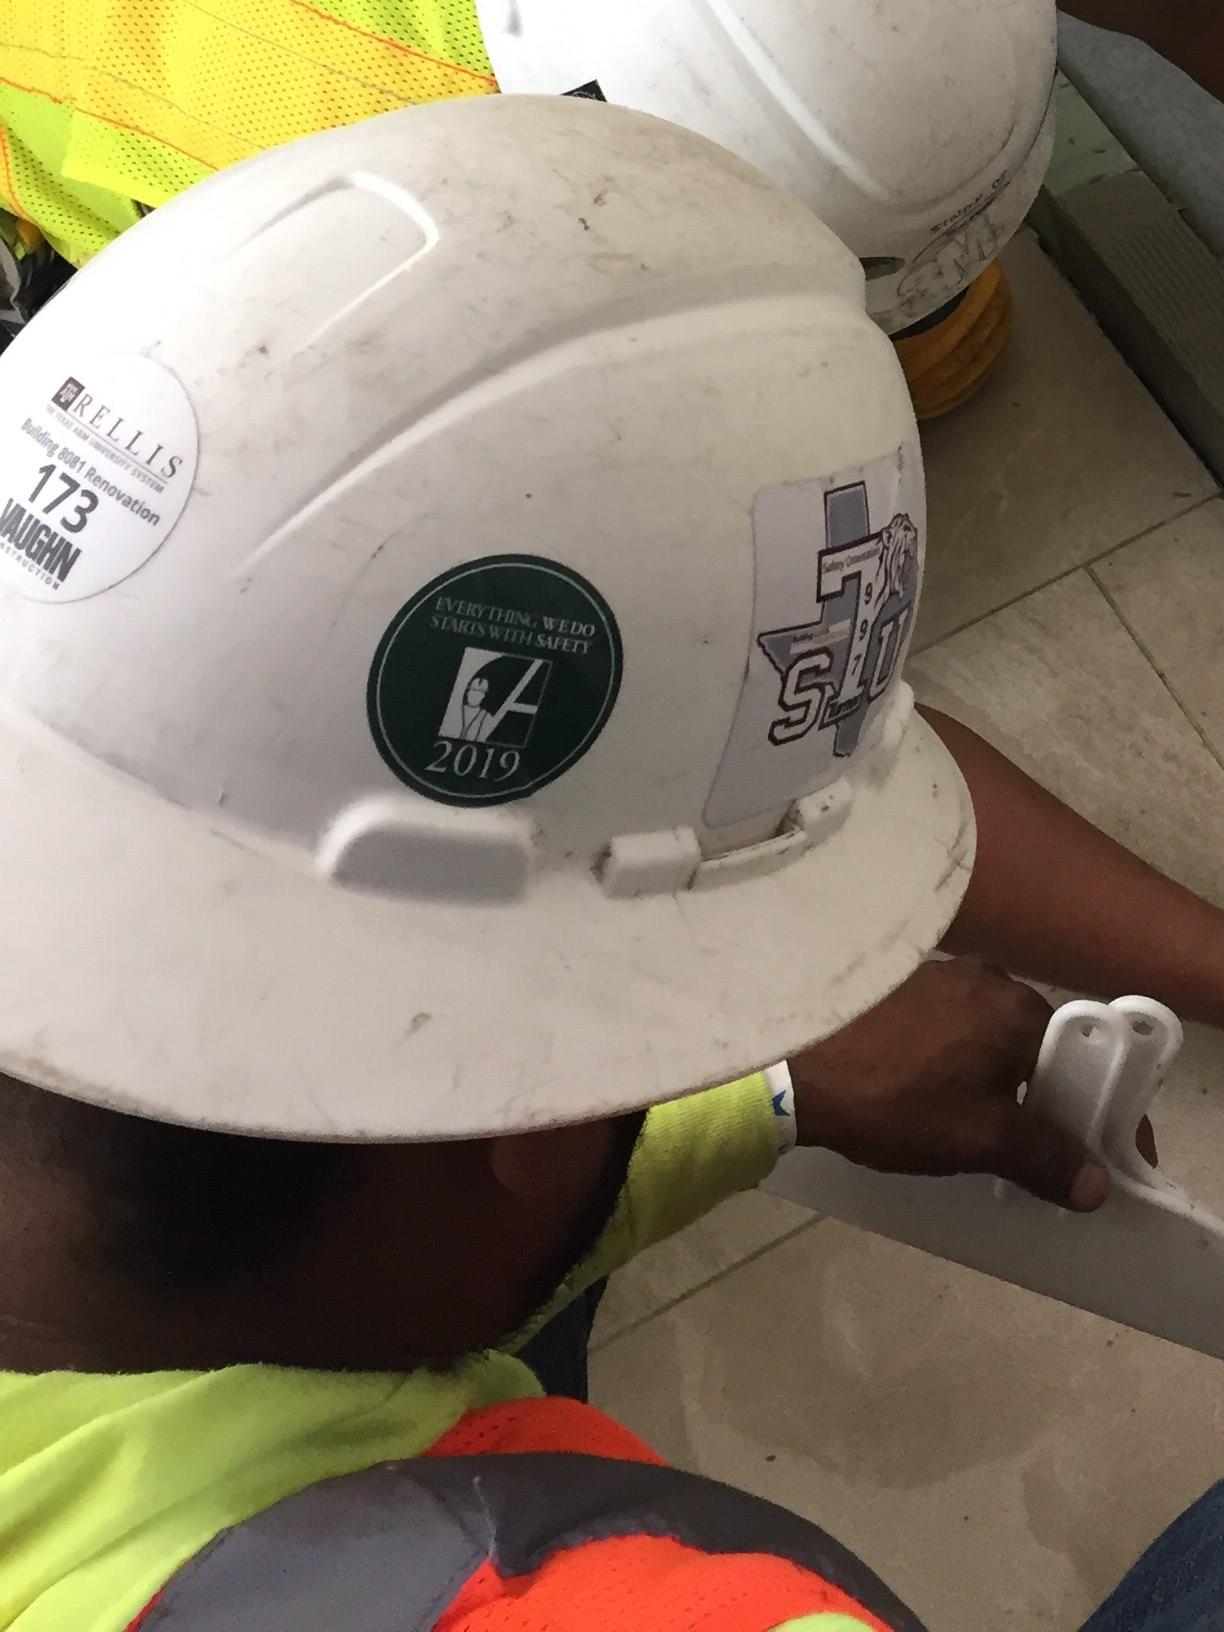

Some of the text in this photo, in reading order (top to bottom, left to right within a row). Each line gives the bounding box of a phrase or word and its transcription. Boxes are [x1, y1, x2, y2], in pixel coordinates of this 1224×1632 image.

[73, 392, 183, 479] RELLIS
[88, 436, 131, 471] UNIVERSITY
[130, 467, 165, 494] SYSTEM
[21, 418, 161, 527] Building 8081 Renovation
[28, 464, 99, 534] 173
[0, 497, 82, 583] VAUGHN
[428, 615, 593, 655] STARTS WITH SAFETY
[435, 595, 538, 628] EVERYTHING
[423, 739, 521, 783] 2019
